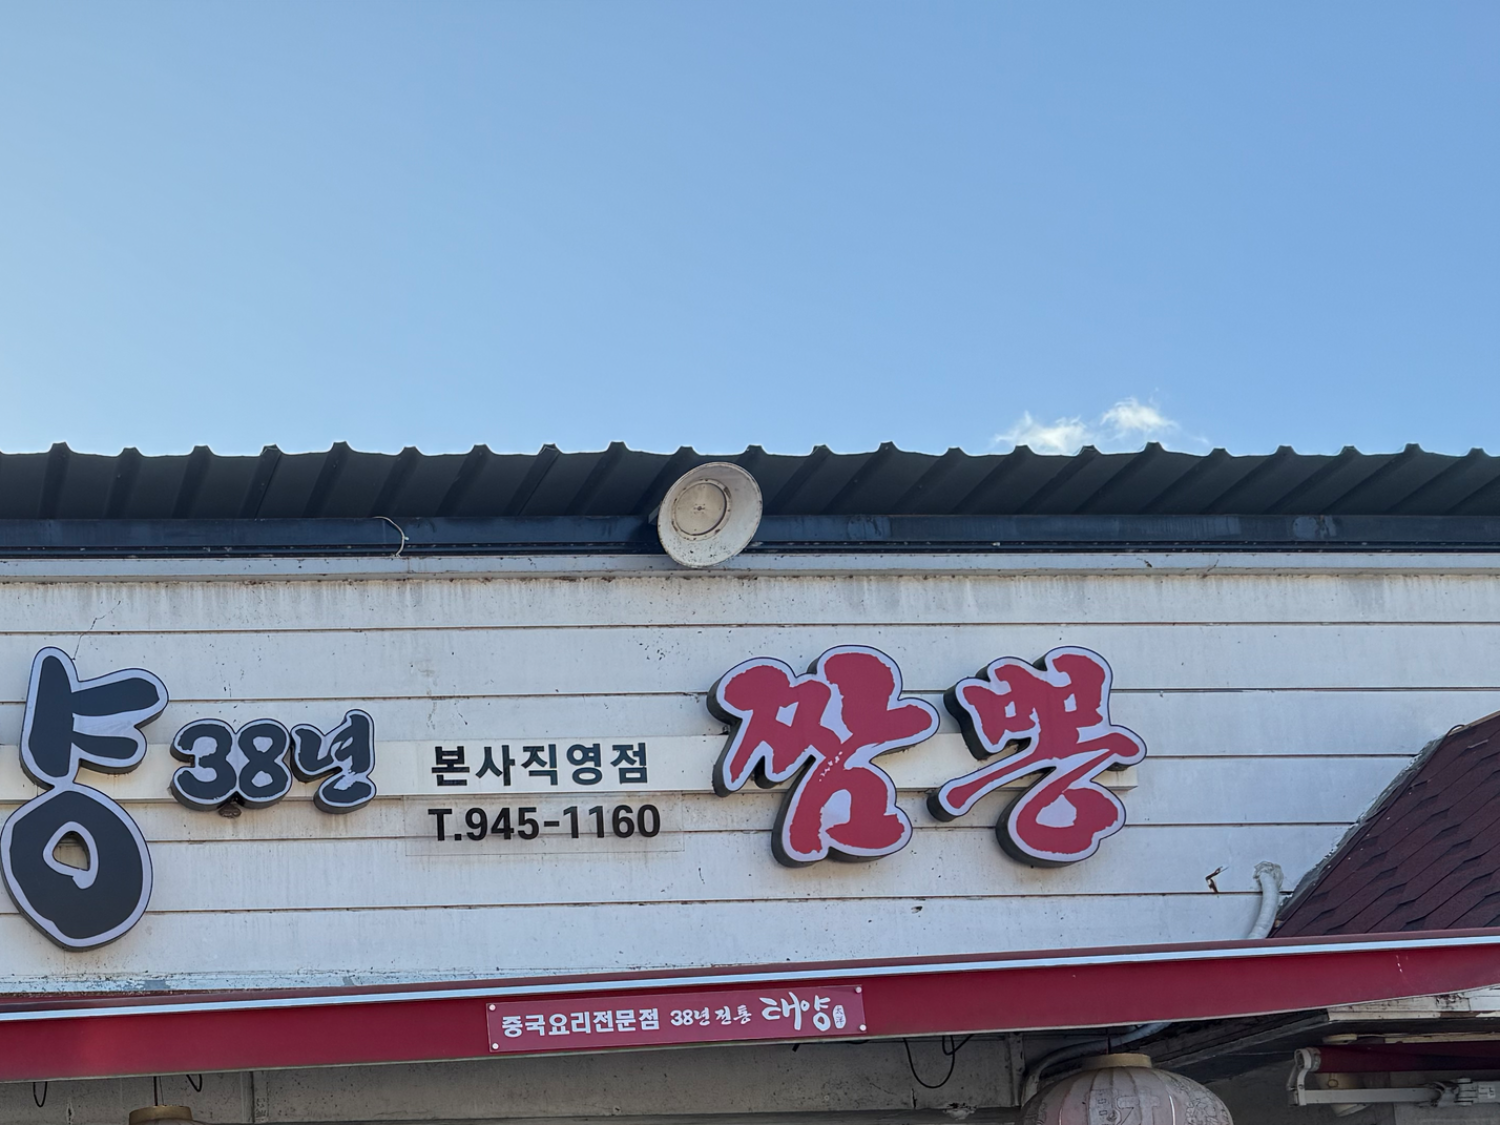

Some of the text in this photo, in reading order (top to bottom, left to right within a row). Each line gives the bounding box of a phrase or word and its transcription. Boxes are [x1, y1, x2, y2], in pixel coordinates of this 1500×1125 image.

[170, 709, 377, 812] 38년
[430, 742, 649, 787] 본사직영점
[708, 644, 1147, 867] 짬뽕
[428, 804, 661, 842] T.945-1160
[501, 991, 831, 1038] 중국요리전문점 38년 전통 태양
